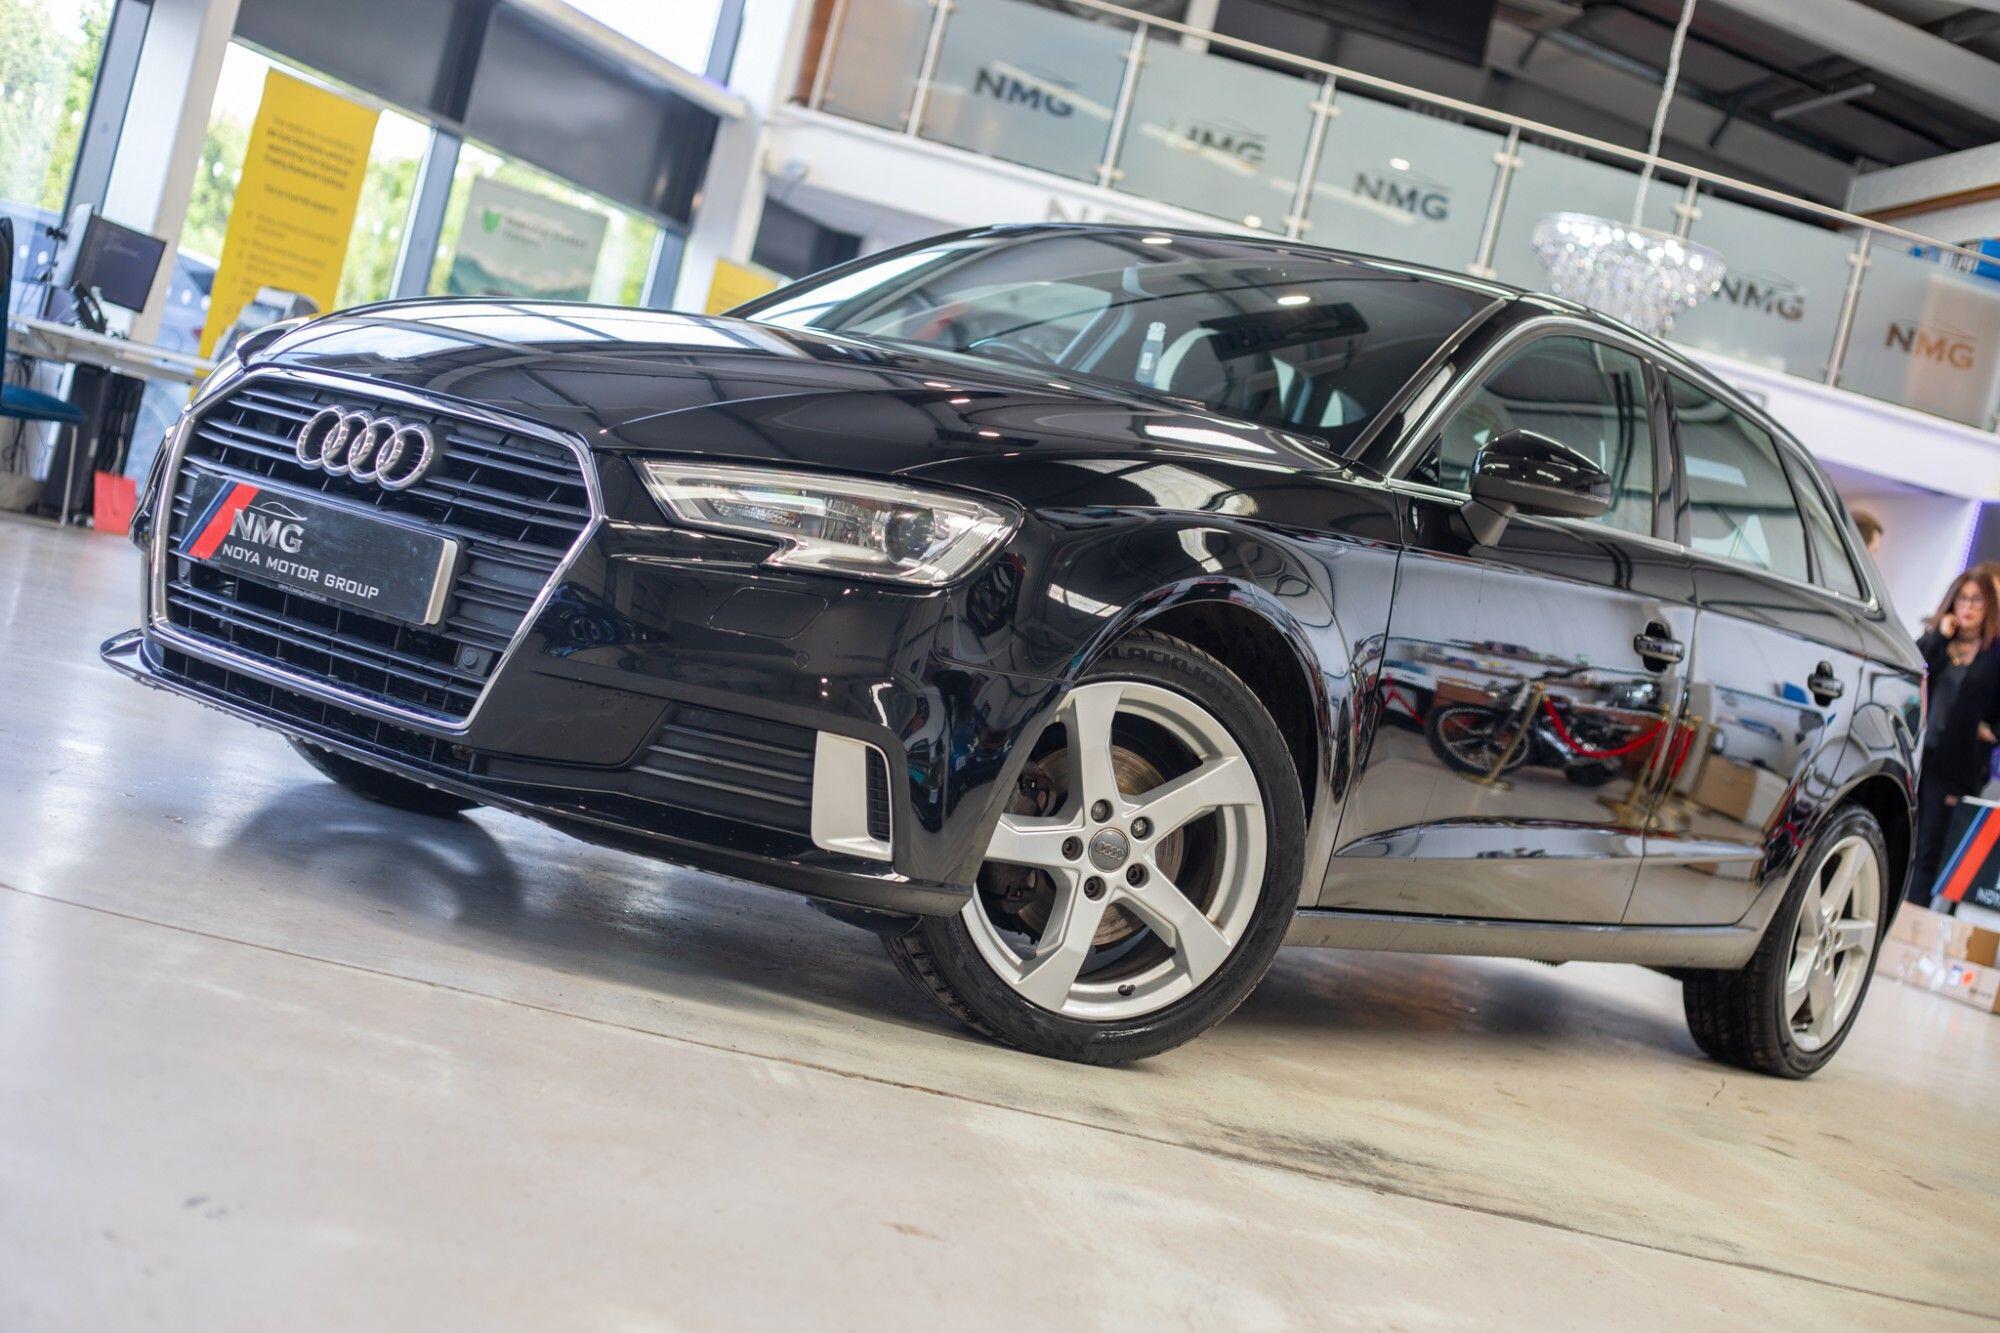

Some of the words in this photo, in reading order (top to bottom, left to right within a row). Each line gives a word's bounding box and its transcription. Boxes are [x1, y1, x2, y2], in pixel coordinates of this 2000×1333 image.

[973, 67, 1074, 118] NMG
[1353, 171, 1449, 221] NMG
[1712, 277, 1805, 321] NMG
[1885, 322, 1976, 370] NMG
[227, 508, 306, 554] NMG
[222, 543, 261, 566] NOYA
[266, 557, 320, 583] MOTOR
[324, 573, 380, 600] GROUP
